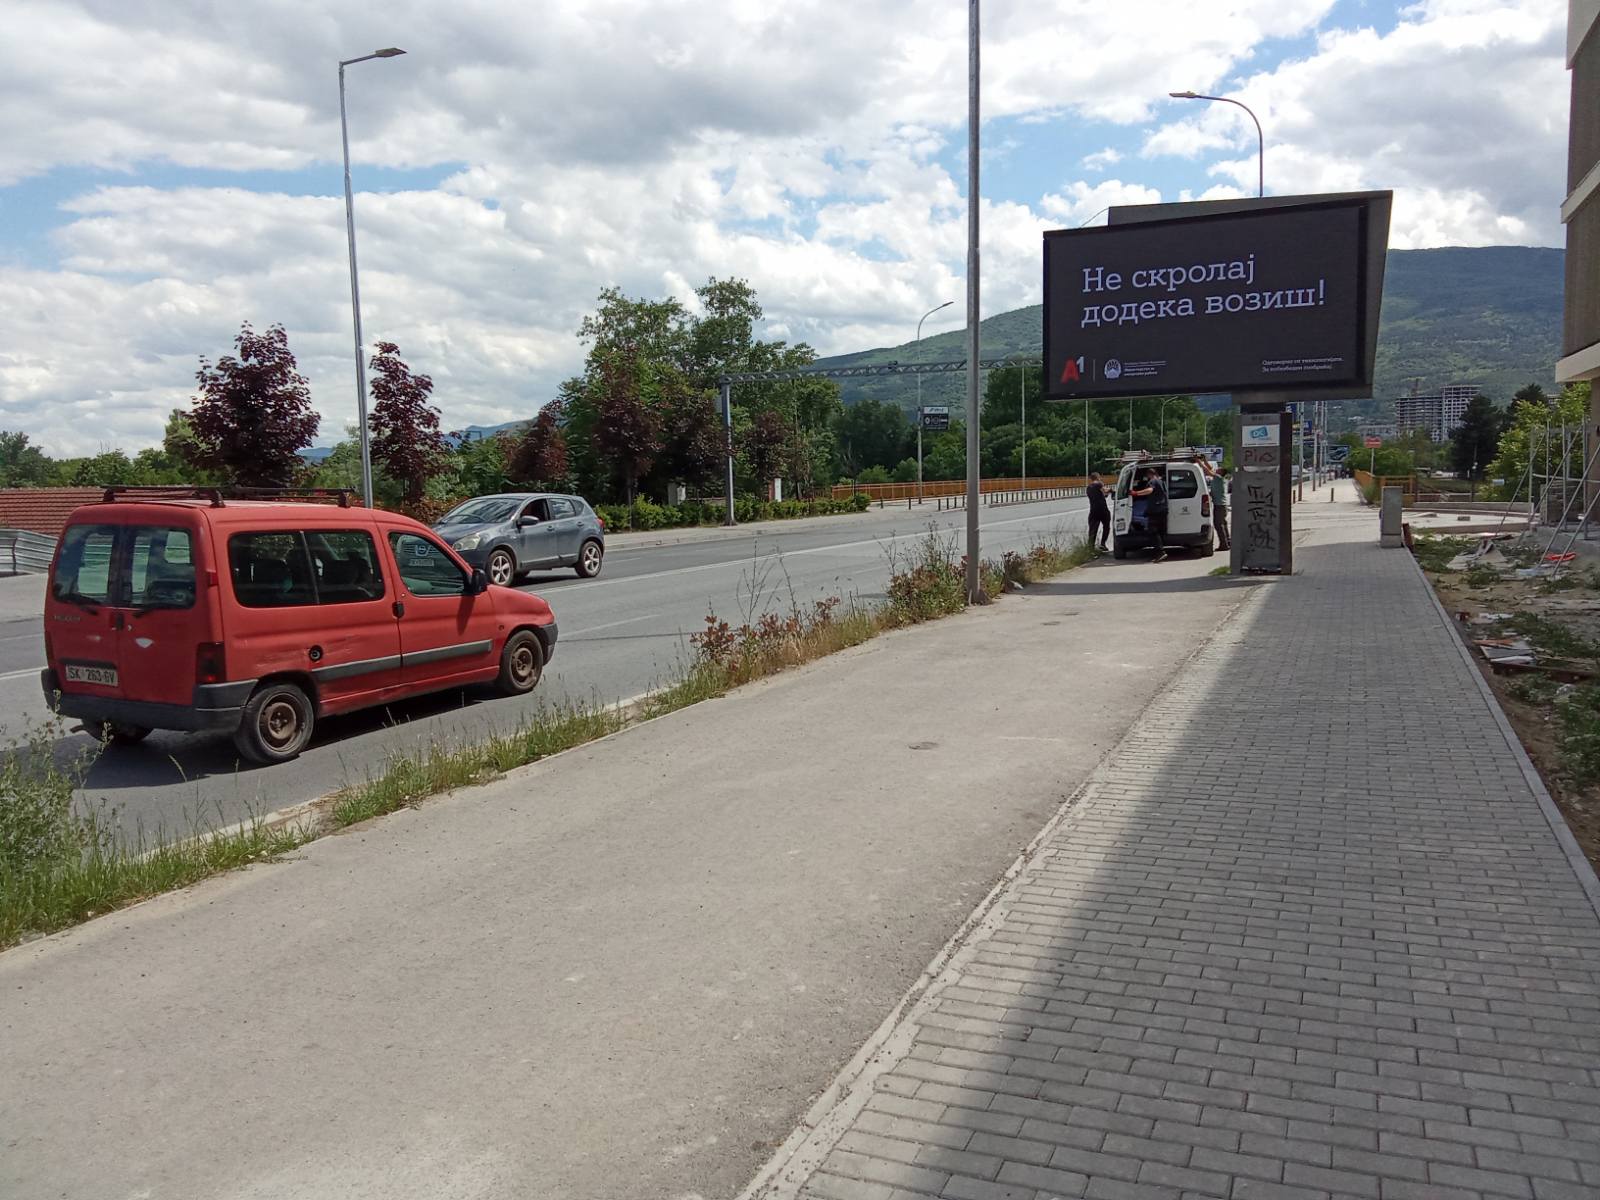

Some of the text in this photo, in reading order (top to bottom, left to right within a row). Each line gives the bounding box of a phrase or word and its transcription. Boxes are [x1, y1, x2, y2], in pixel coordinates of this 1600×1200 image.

[1082, 254, 1255, 293] Не скролај
[1081, 279, 1325, 328] додека возиш!
[1061, 356, 1085, 384] A1
[69, 667, 81, 679] SK
